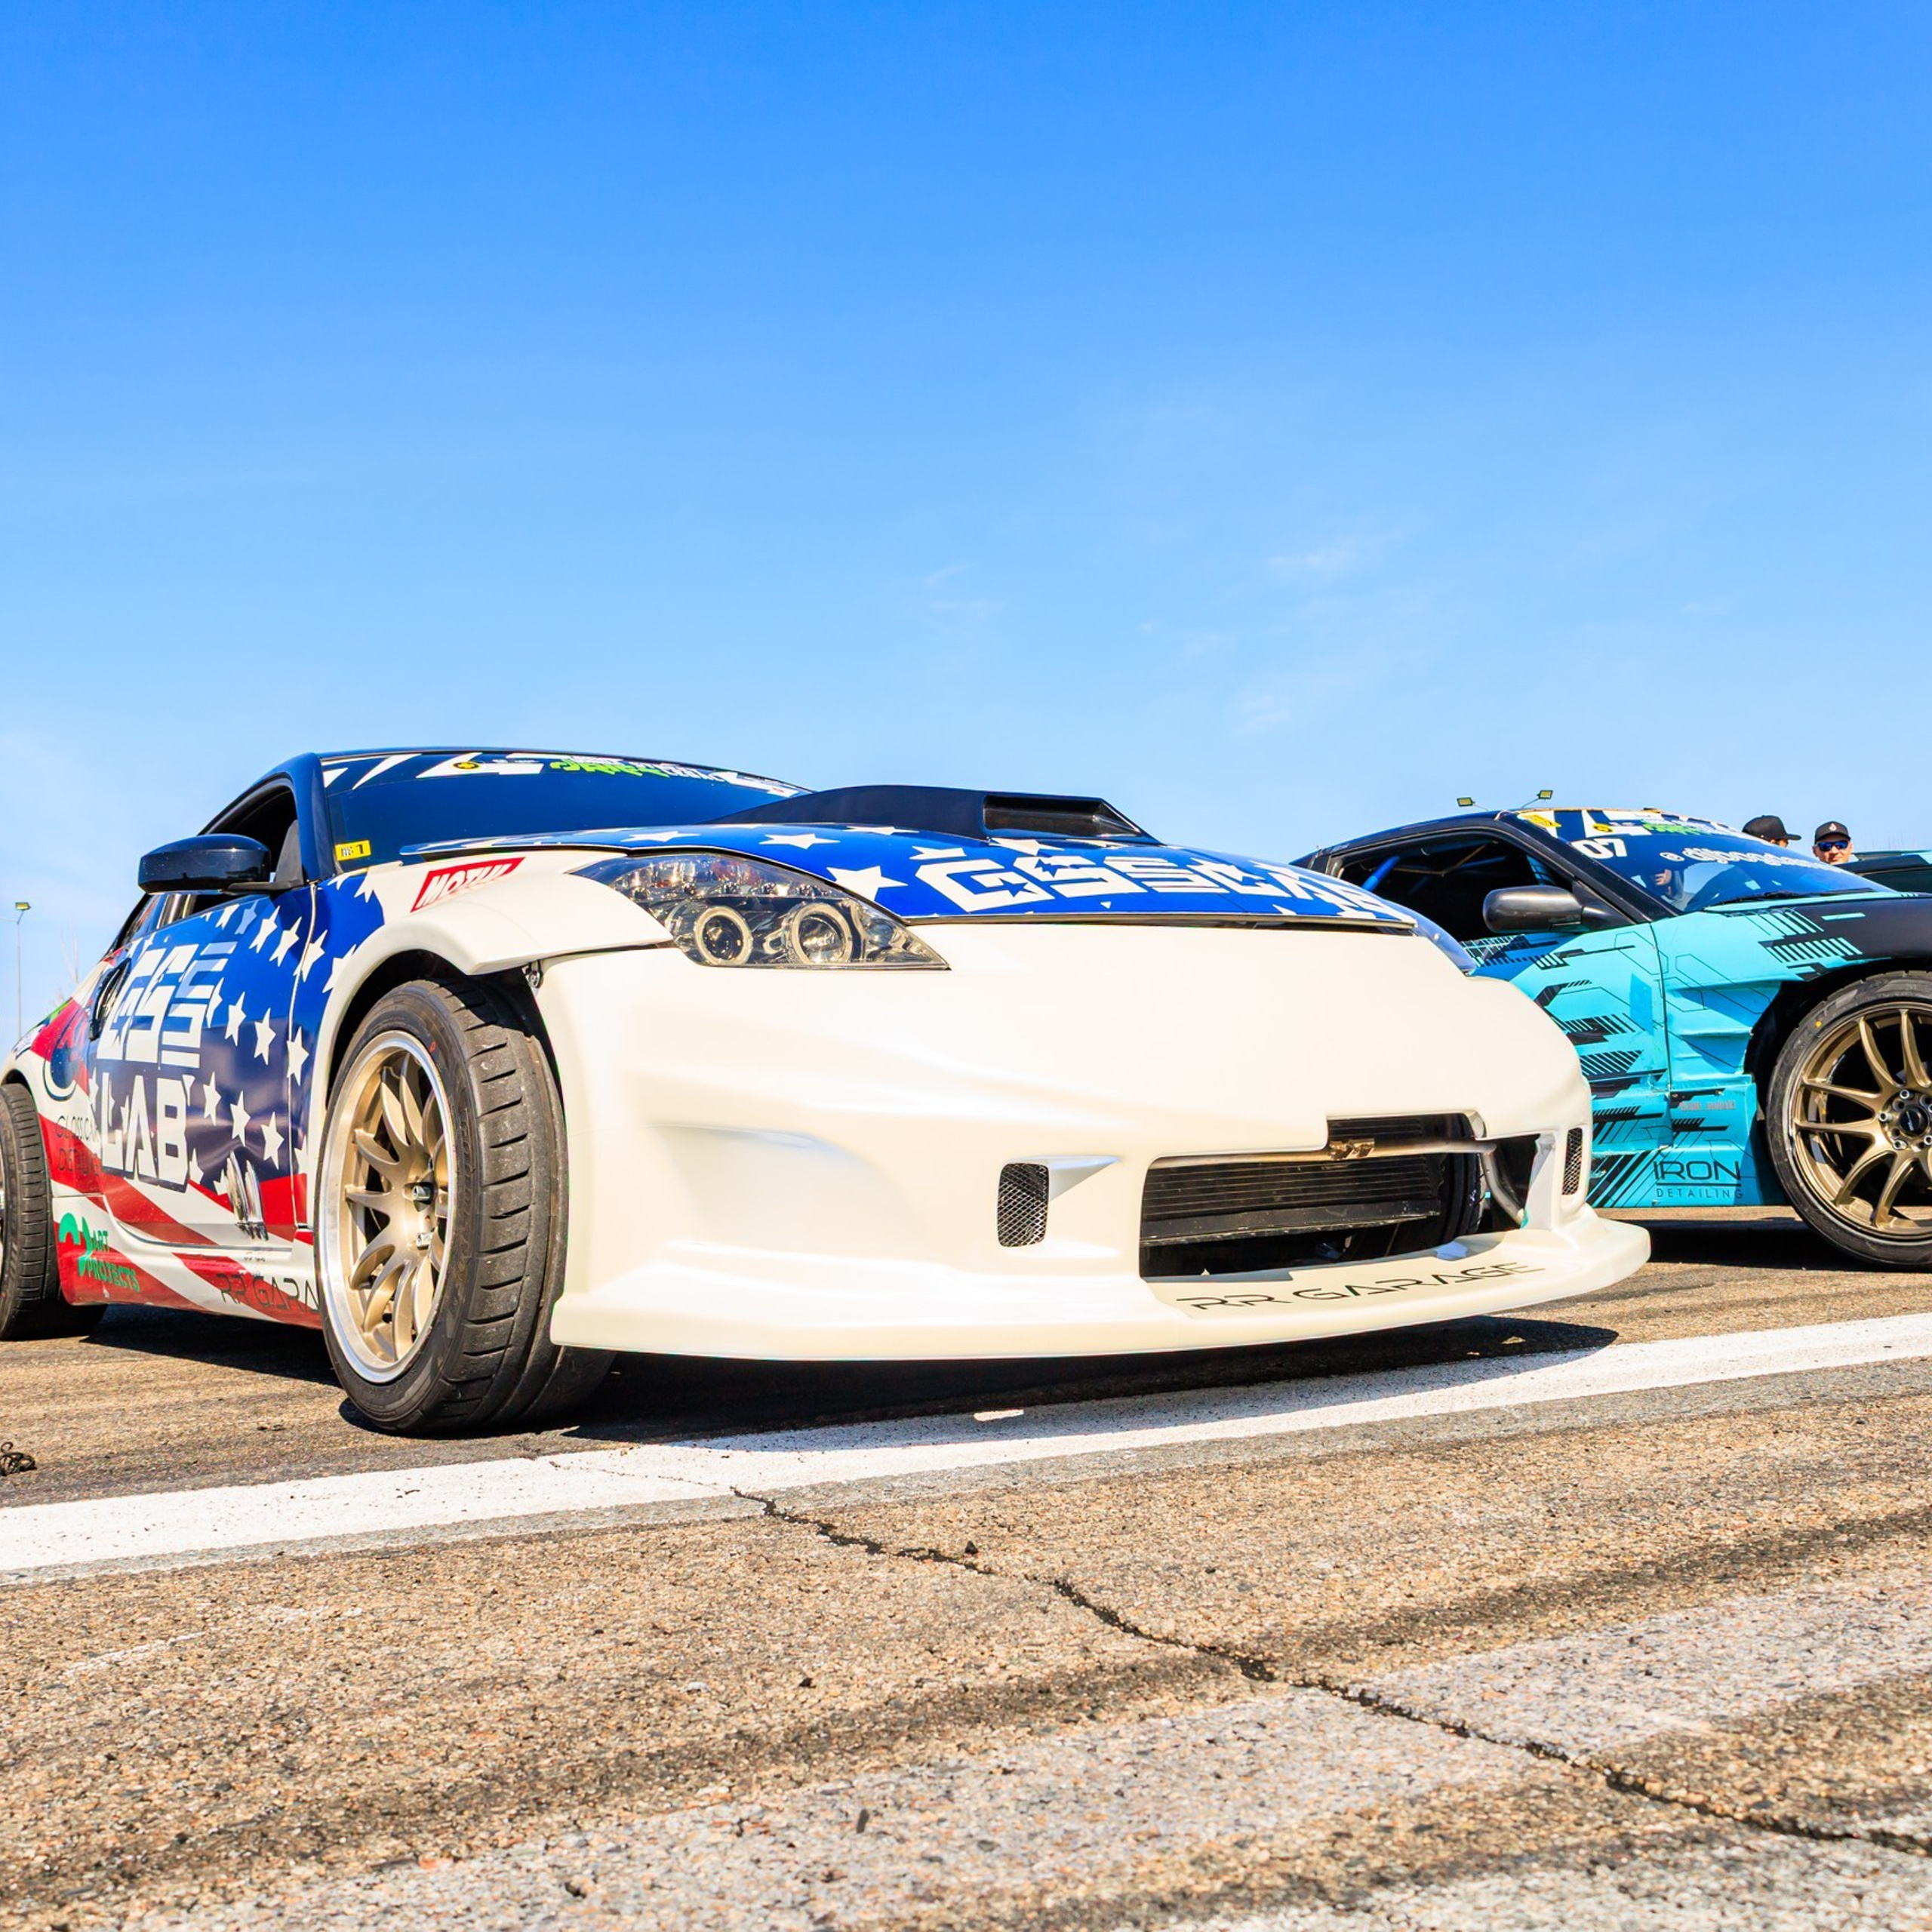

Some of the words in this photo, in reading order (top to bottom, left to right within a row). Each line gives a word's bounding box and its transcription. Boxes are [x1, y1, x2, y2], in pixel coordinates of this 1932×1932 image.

[1571, 838, 1627, 859] 07
[101, 1071, 189, 1187] LAB
[1653, 1161, 1741, 1180] IRON
[1656, 1188, 1743, 1199] DETAILING
[87, 1257, 140, 1293] PROJECTS
[214, 1272, 250, 1305] RR
[1177, 1294, 1292, 1310] RR
[1291, 1262, 1546, 1301] GARAGE
